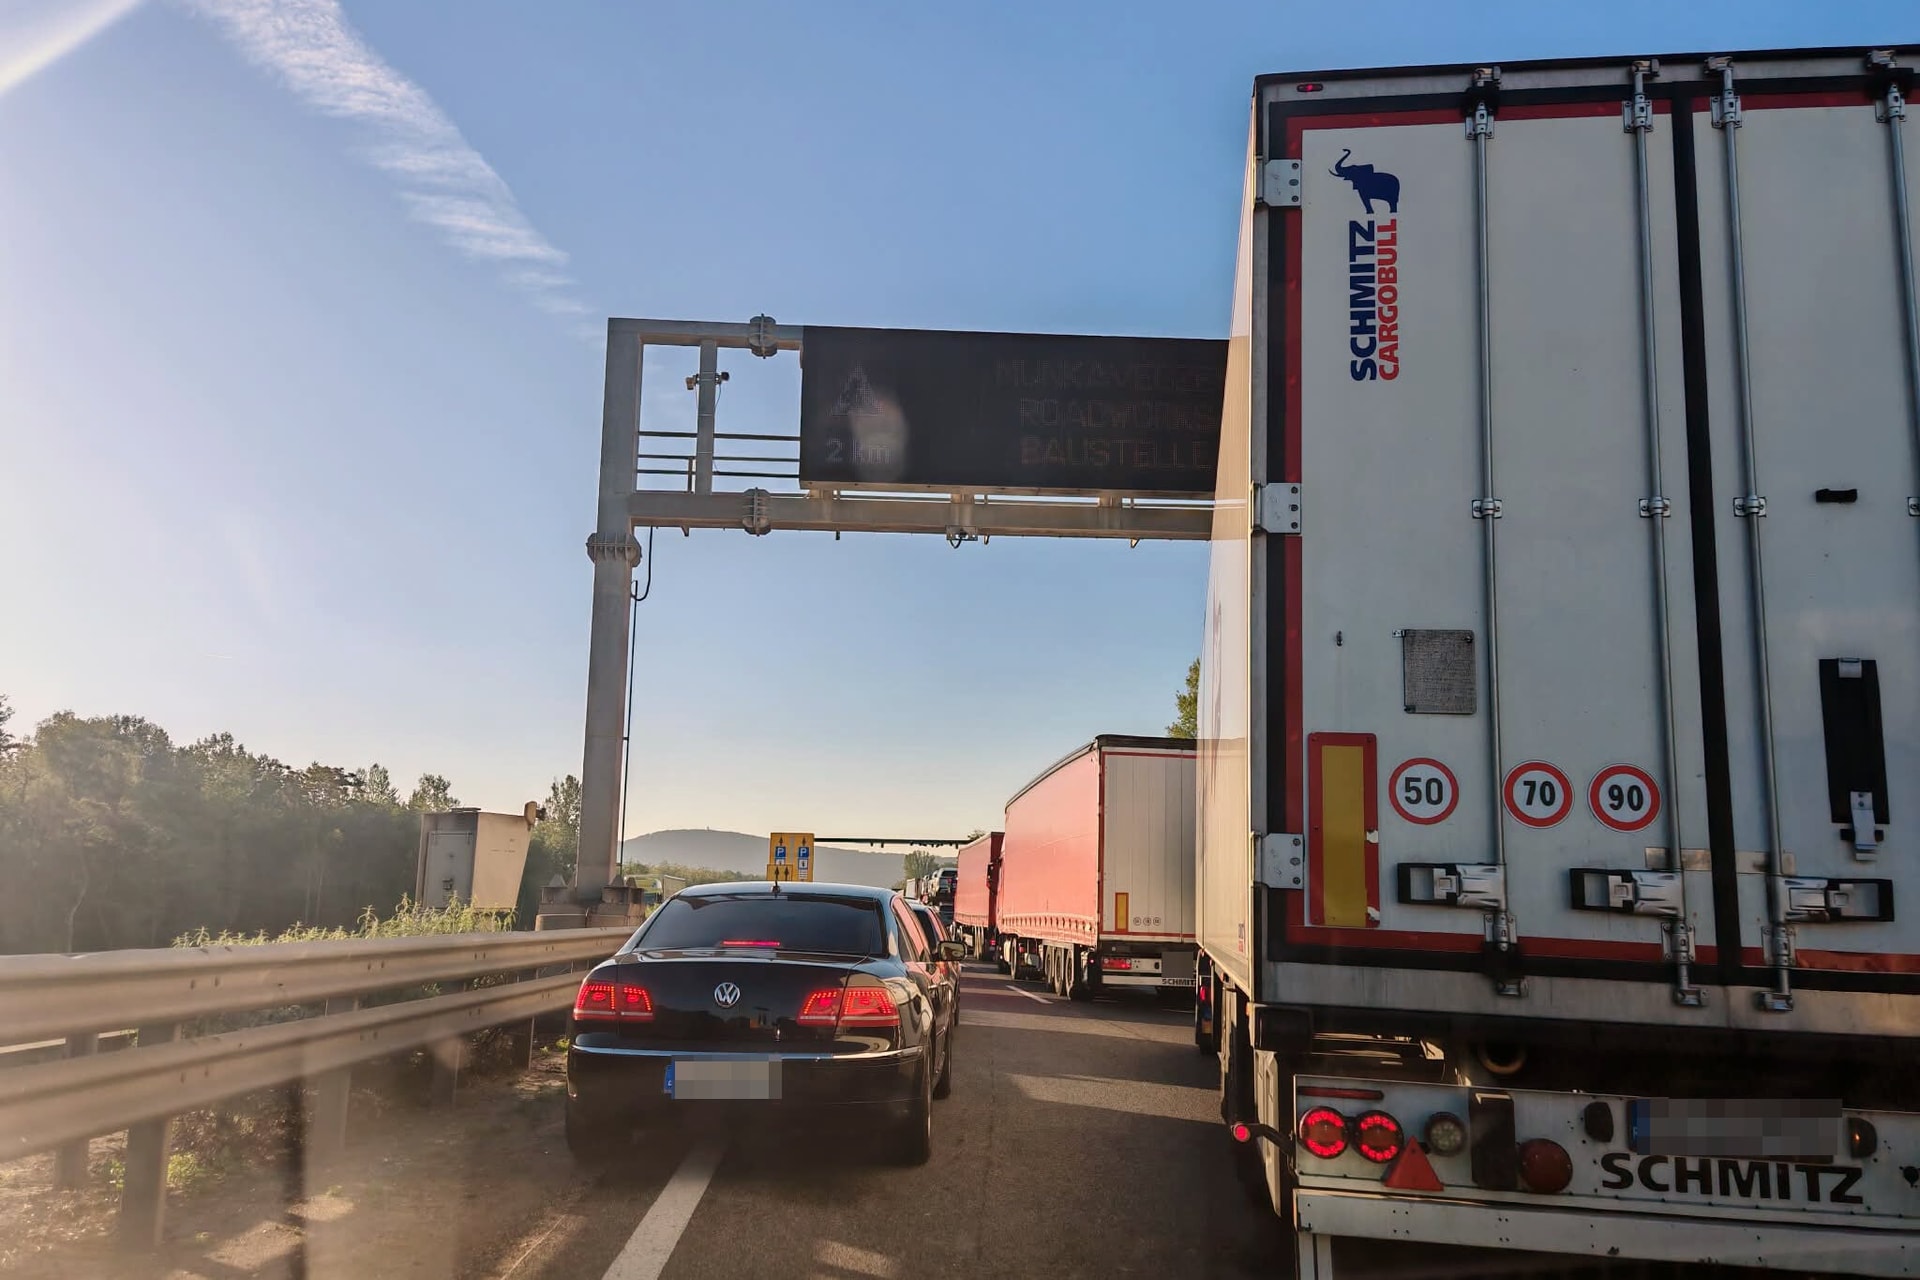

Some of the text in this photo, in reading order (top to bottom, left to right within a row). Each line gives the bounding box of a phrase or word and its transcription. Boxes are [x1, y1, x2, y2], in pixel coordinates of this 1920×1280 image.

[1349, 220, 1378, 381] SCHMITZ
[1377, 219, 1400, 381] CARGOBULL
[825, 437, 843, 463] 2
[1404, 776, 1443, 806] 50
[1523, 780, 1556, 807] 70
[1608, 784, 1643, 811] 90
[777, 847, 785, 857] P
[800, 847, 807, 857] P
[1161, 978, 1196, 986] SCHMIT
[1600, 1152, 1864, 1204] SCHMITZ
